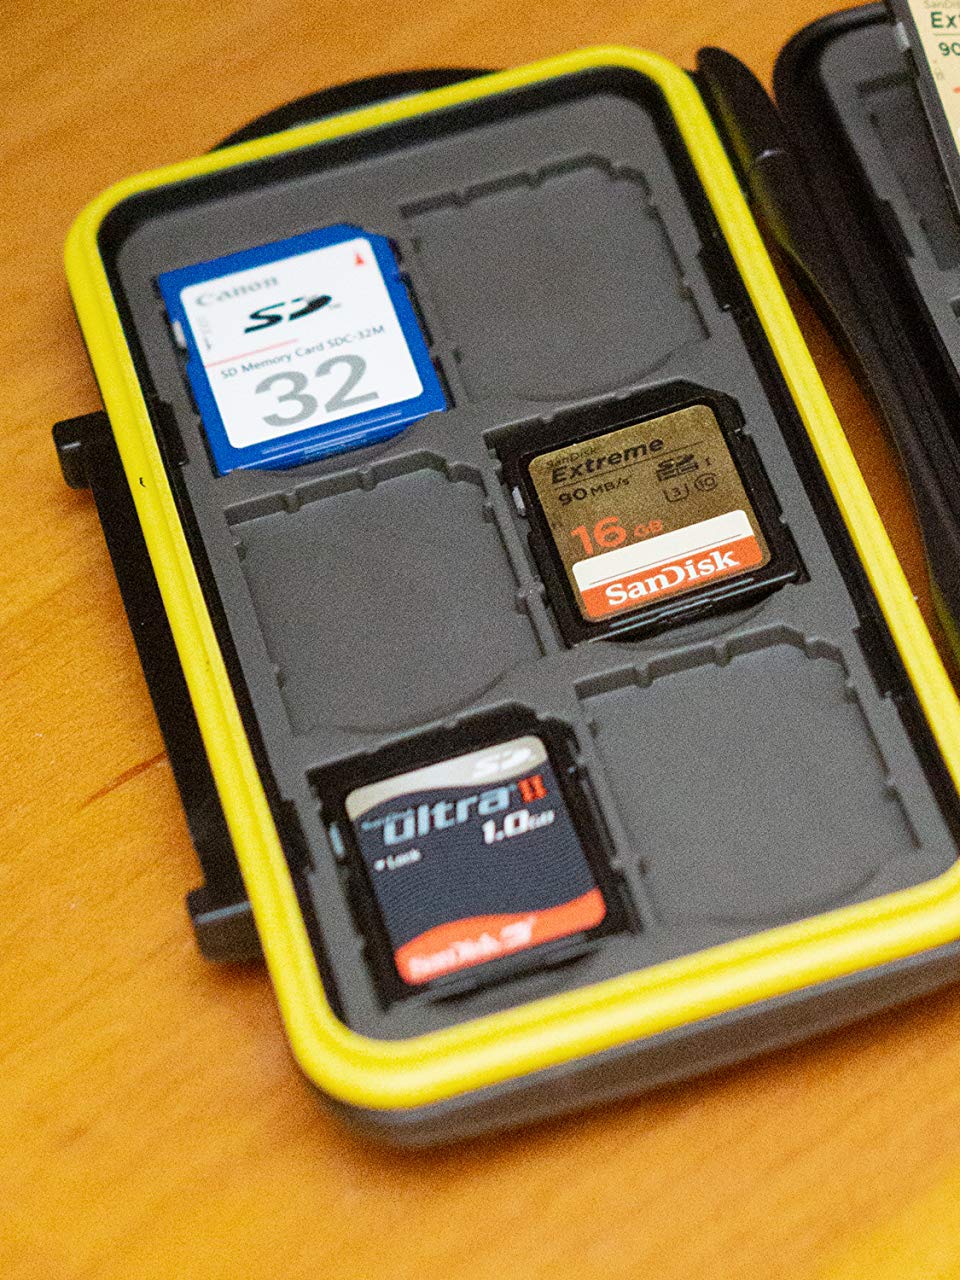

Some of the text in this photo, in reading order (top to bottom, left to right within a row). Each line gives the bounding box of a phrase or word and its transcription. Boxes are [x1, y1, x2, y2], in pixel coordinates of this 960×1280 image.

[195, 276, 279, 306] Canon
[221, 325, 385, 379] SD Memory Card SDC-32M
[254, 354, 380, 428] 32
[551, 438, 665, 485] Extreme
[570, 516, 663, 556] 16 GB
[604, 548, 740, 606] SanDisk
[517, 775, 549, 804] II
